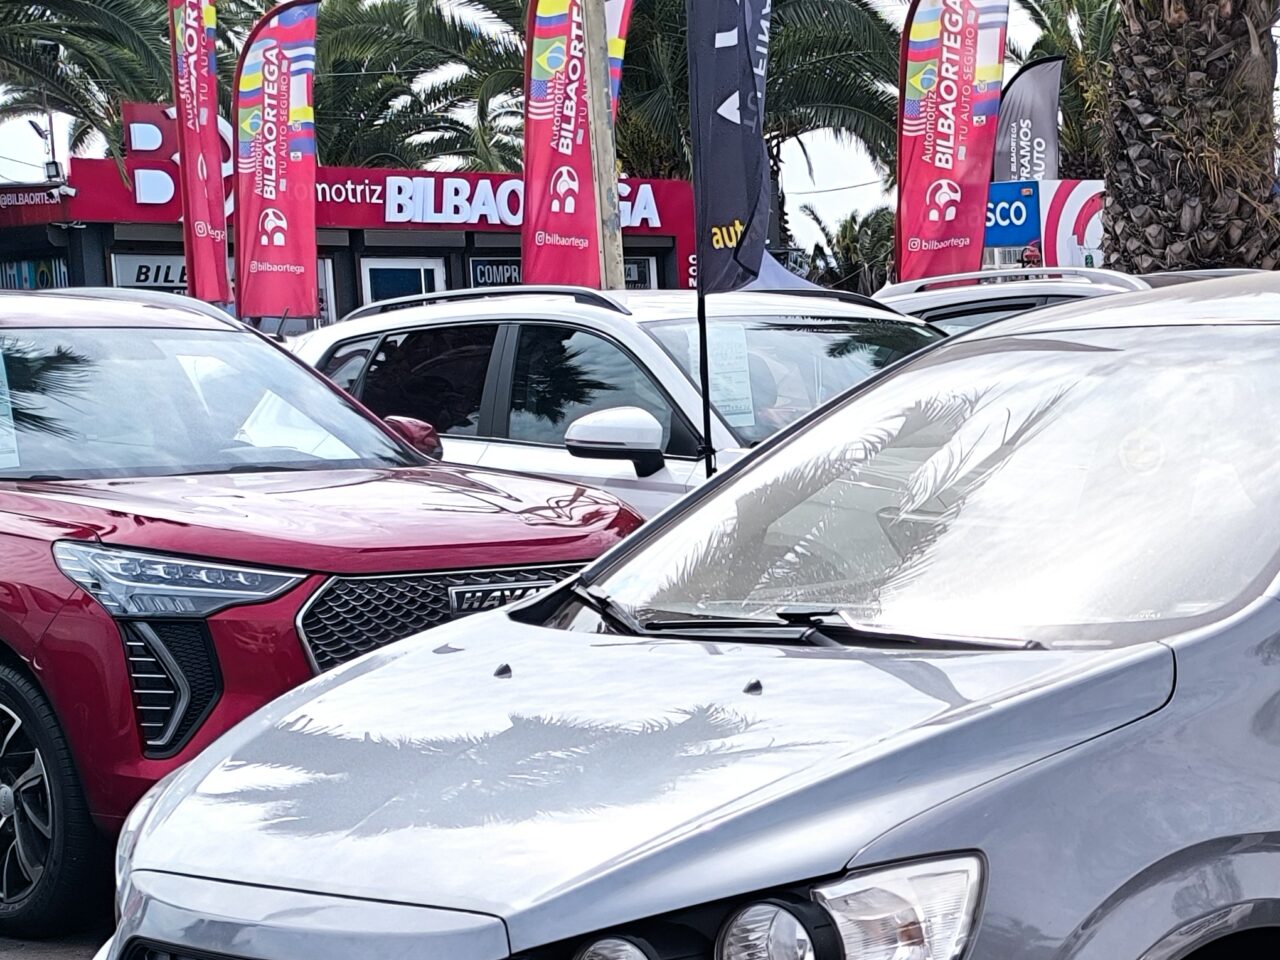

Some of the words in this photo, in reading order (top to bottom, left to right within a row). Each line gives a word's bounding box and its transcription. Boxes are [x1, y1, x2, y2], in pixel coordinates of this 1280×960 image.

[963, 27, 976, 84] SEGURO
[200, 83, 208, 102] TU
[280, 76, 289, 123] SEGURO
[934, 0, 964, 170] BILBAORTEGA
[960, 85, 973, 122] AUTO
[263, 47, 279, 201] BILBAORTEGA
[550, 71, 566, 150] Automotriz
[922, 90, 937, 164] Automotriz
[279, 126, 287, 158] AUTO
[958, 125, 968, 142] TU
[254, 132, 263, 196] Automotriz
[279, 161, 287, 175] TU
[1033, 137, 1046, 180] AUTO
[545, 235, 589, 249] bilbaortega
[922, 237, 970, 251] bilbaortega
[257, 260, 305, 273] bilbaortega
[476, 264, 523, 284] COMPR
